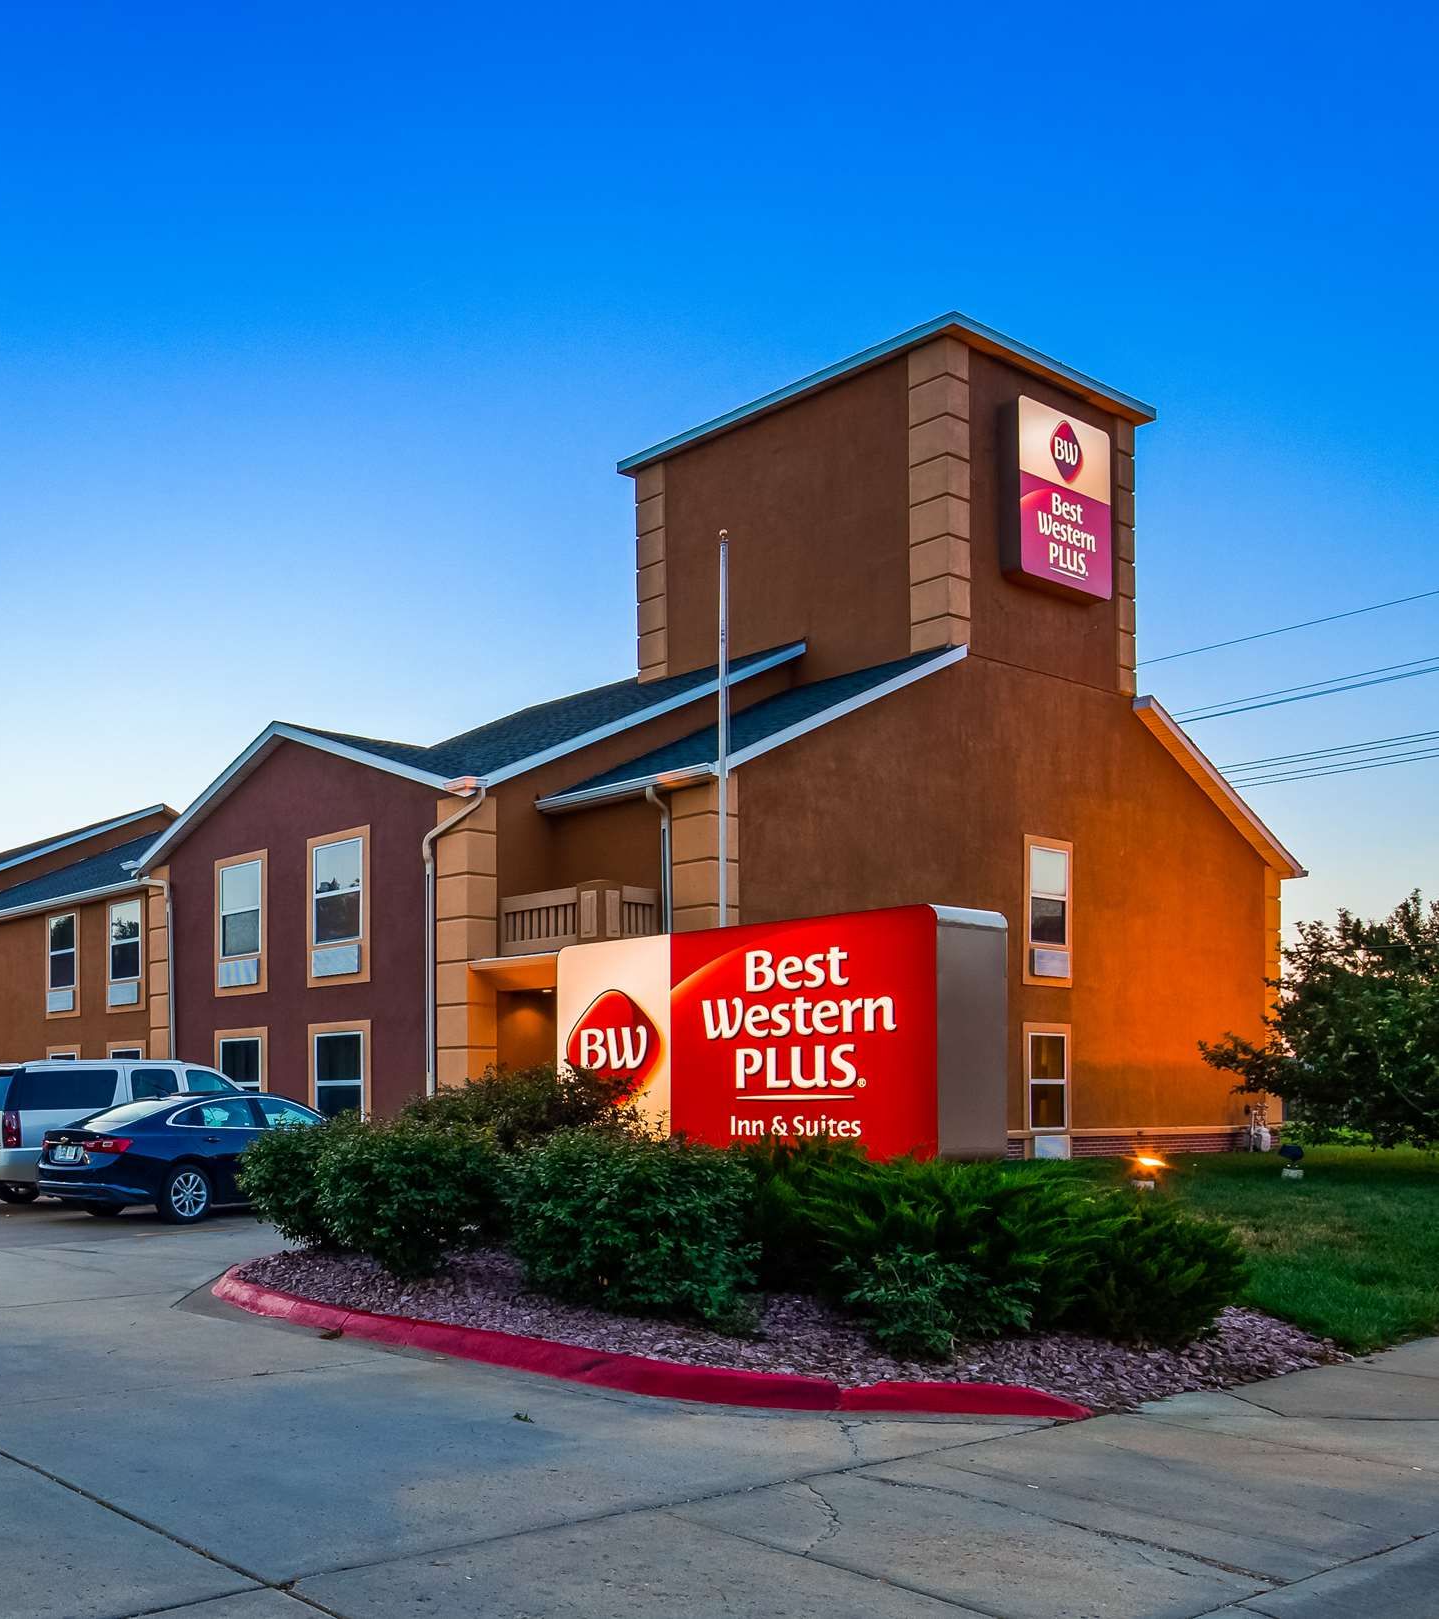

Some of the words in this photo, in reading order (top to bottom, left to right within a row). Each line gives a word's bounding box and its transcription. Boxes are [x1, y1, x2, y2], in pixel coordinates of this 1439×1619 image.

[1054, 437, 1079, 466] BW
[1051, 492, 1083, 525] Best
[1037, 510, 1096, 553] Western
[745, 946, 849, 992] Best
[702, 996, 897, 1040] Western
[580, 1025, 647, 1070] BW
[730, 1115, 765, 1136] Inn
[770, 1115, 789, 1136] &
[792, 1114, 862, 1137] Suites
